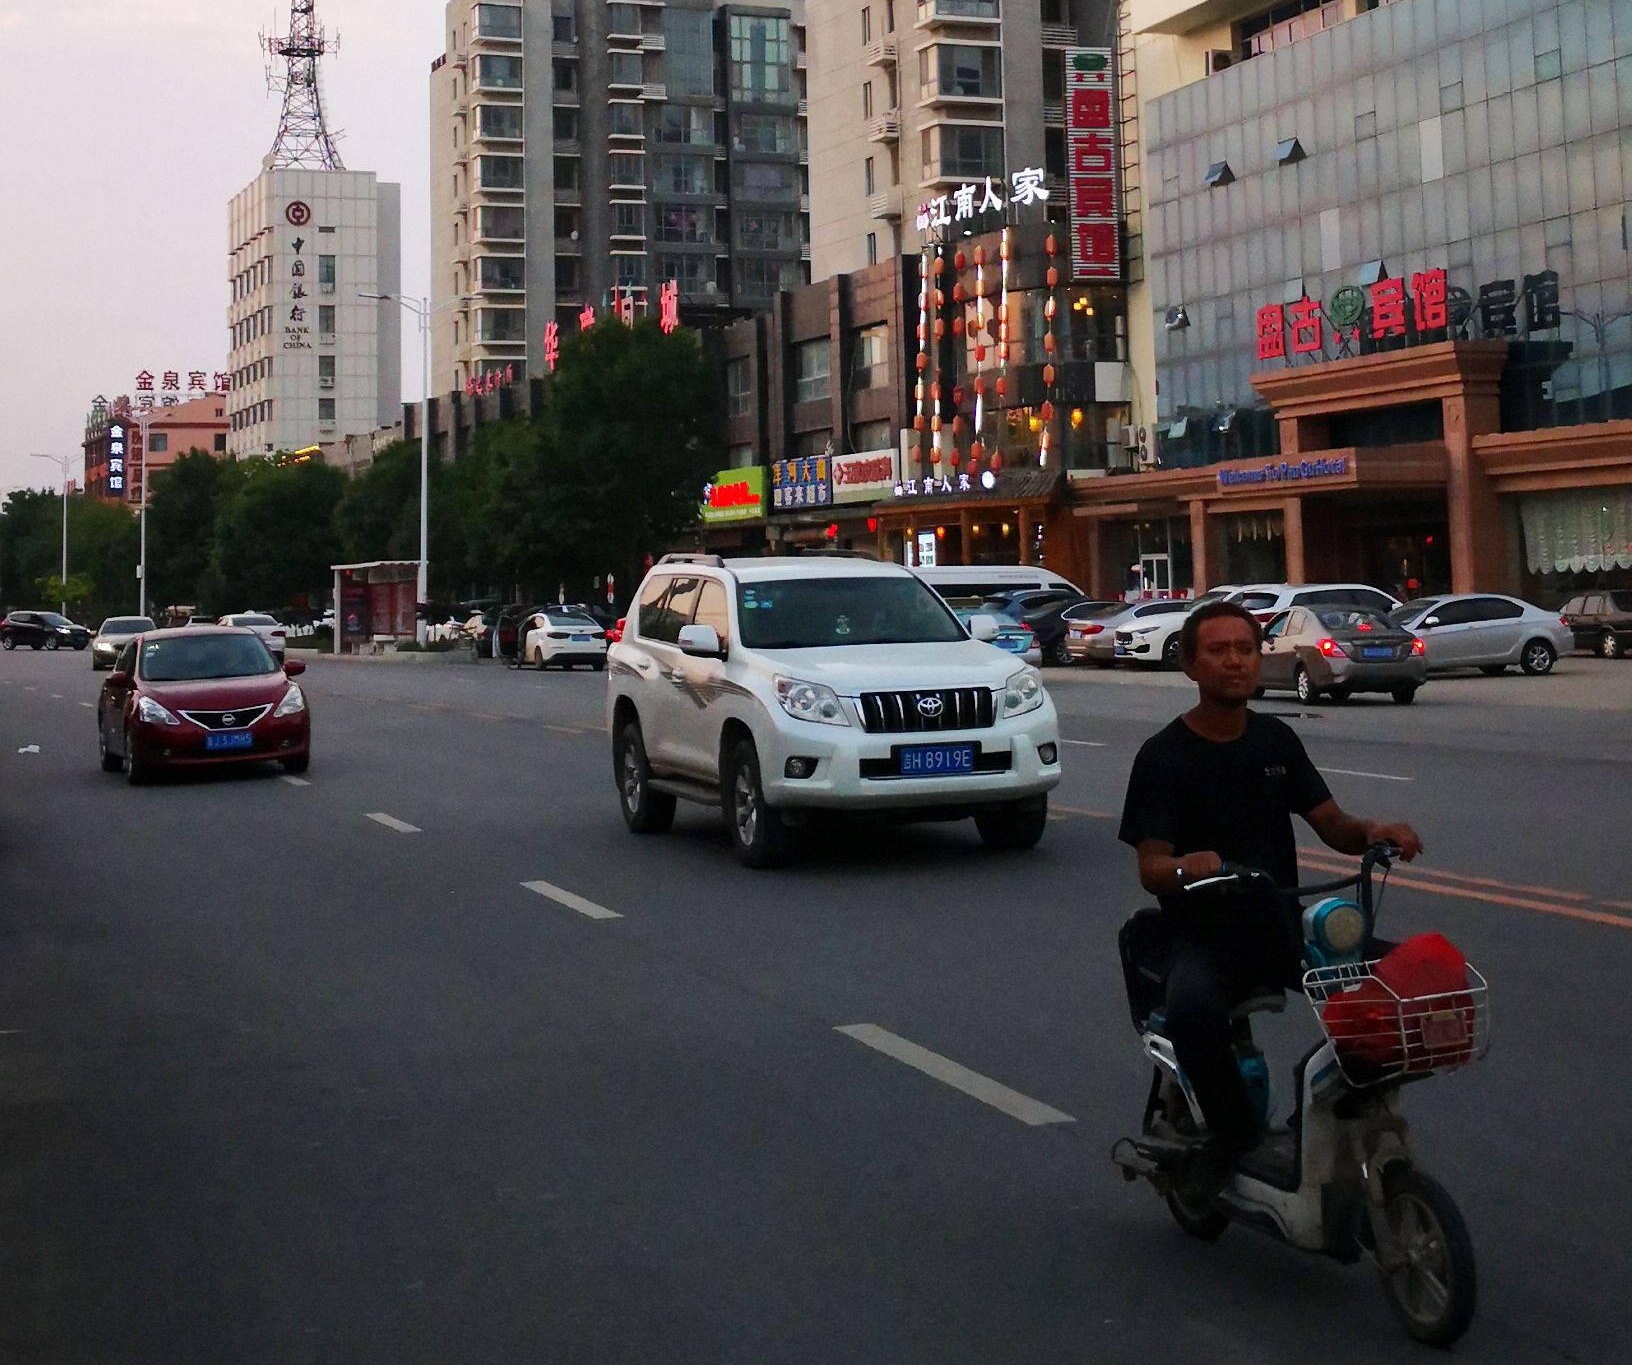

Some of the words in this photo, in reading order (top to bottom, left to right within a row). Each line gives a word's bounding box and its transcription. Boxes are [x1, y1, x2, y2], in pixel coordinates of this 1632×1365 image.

[289, 235, 308, 322] 中国银行
[284, 326, 309, 334] BANK
[1256, 267, 1447, 361] 盘古宾馆
[135, 369, 233, 392] 金泉宾馆
[109, 424, 124, 489] 金泉宾馆
